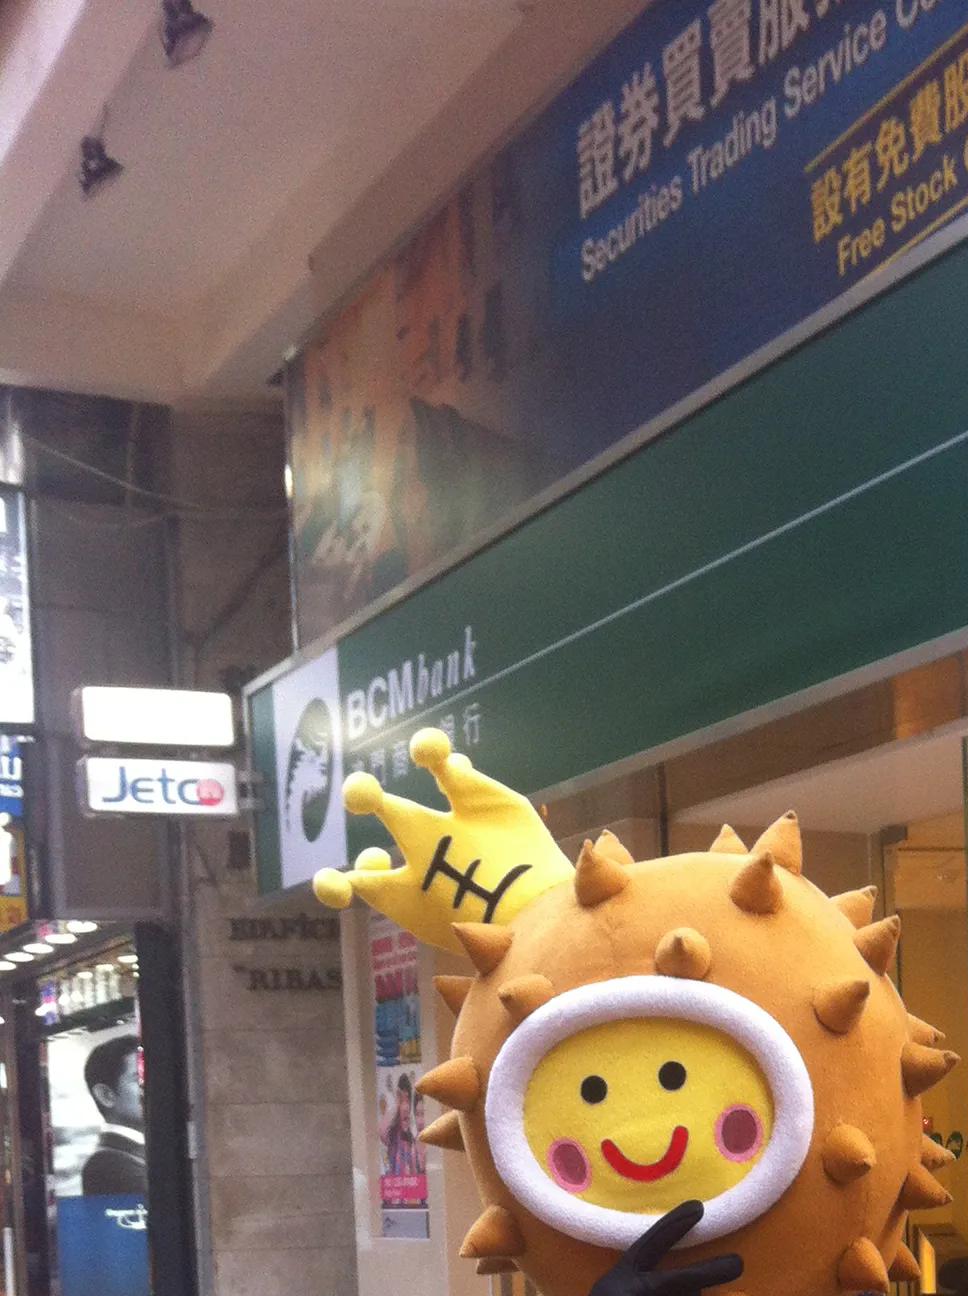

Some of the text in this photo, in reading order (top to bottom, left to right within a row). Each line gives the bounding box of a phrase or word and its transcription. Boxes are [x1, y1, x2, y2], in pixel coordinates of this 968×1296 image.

[581, 9, 887, 282] Securities Trading Service
[837, 218, 887, 276] Free
[890, 155, 959, 232] Stock
